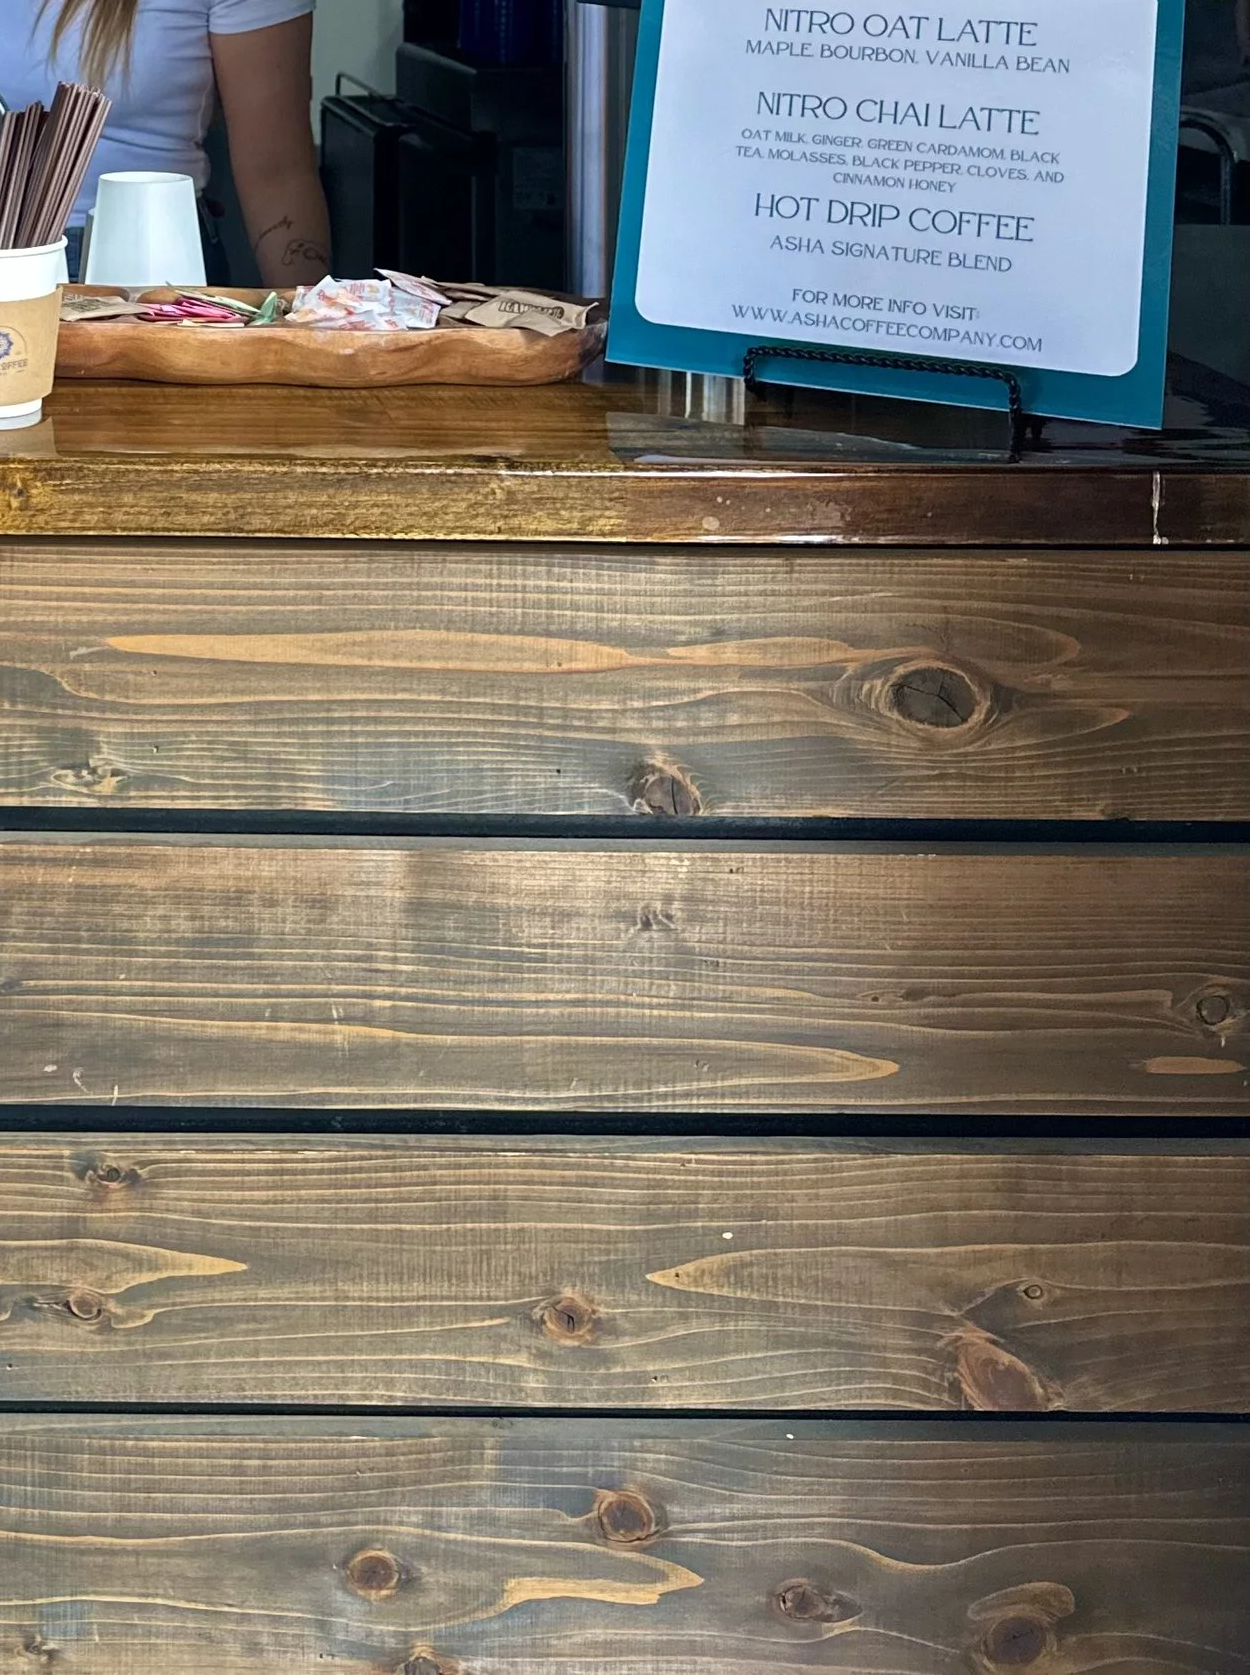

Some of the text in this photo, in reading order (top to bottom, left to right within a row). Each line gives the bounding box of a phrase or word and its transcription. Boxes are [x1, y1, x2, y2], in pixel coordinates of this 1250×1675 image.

[764, 8, 1039, 46] NITRO OAT LATTE
[925, 50, 1010, 70] VANILLA
[1016, 56, 1070, 73] BEAN
[757, 92, 1041, 135] NITRO CHAI LATTE
[741, 128, 772, 140] OAT
[867, 137, 913, 152] GREEN
[1010, 149, 1061, 164] BLACK
[833, 171, 957, 193] CINNAMON HONEY
[852, 155, 899, 170] BLACK
[1033, 171, 1064, 183] AND
[754, 192, 1035, 242] HOT DRIP COFFEE
[770, 234, 1012, 272] ASHA SIGNATURE BLEND
[792, 288, 828, 304] FOR
[832, 292, 883, 311] MORE
[888, 298, 927, 316] INFO
[732, 304, 1043, 352] WWW.ASHACOFFEECOMPANY.COM
